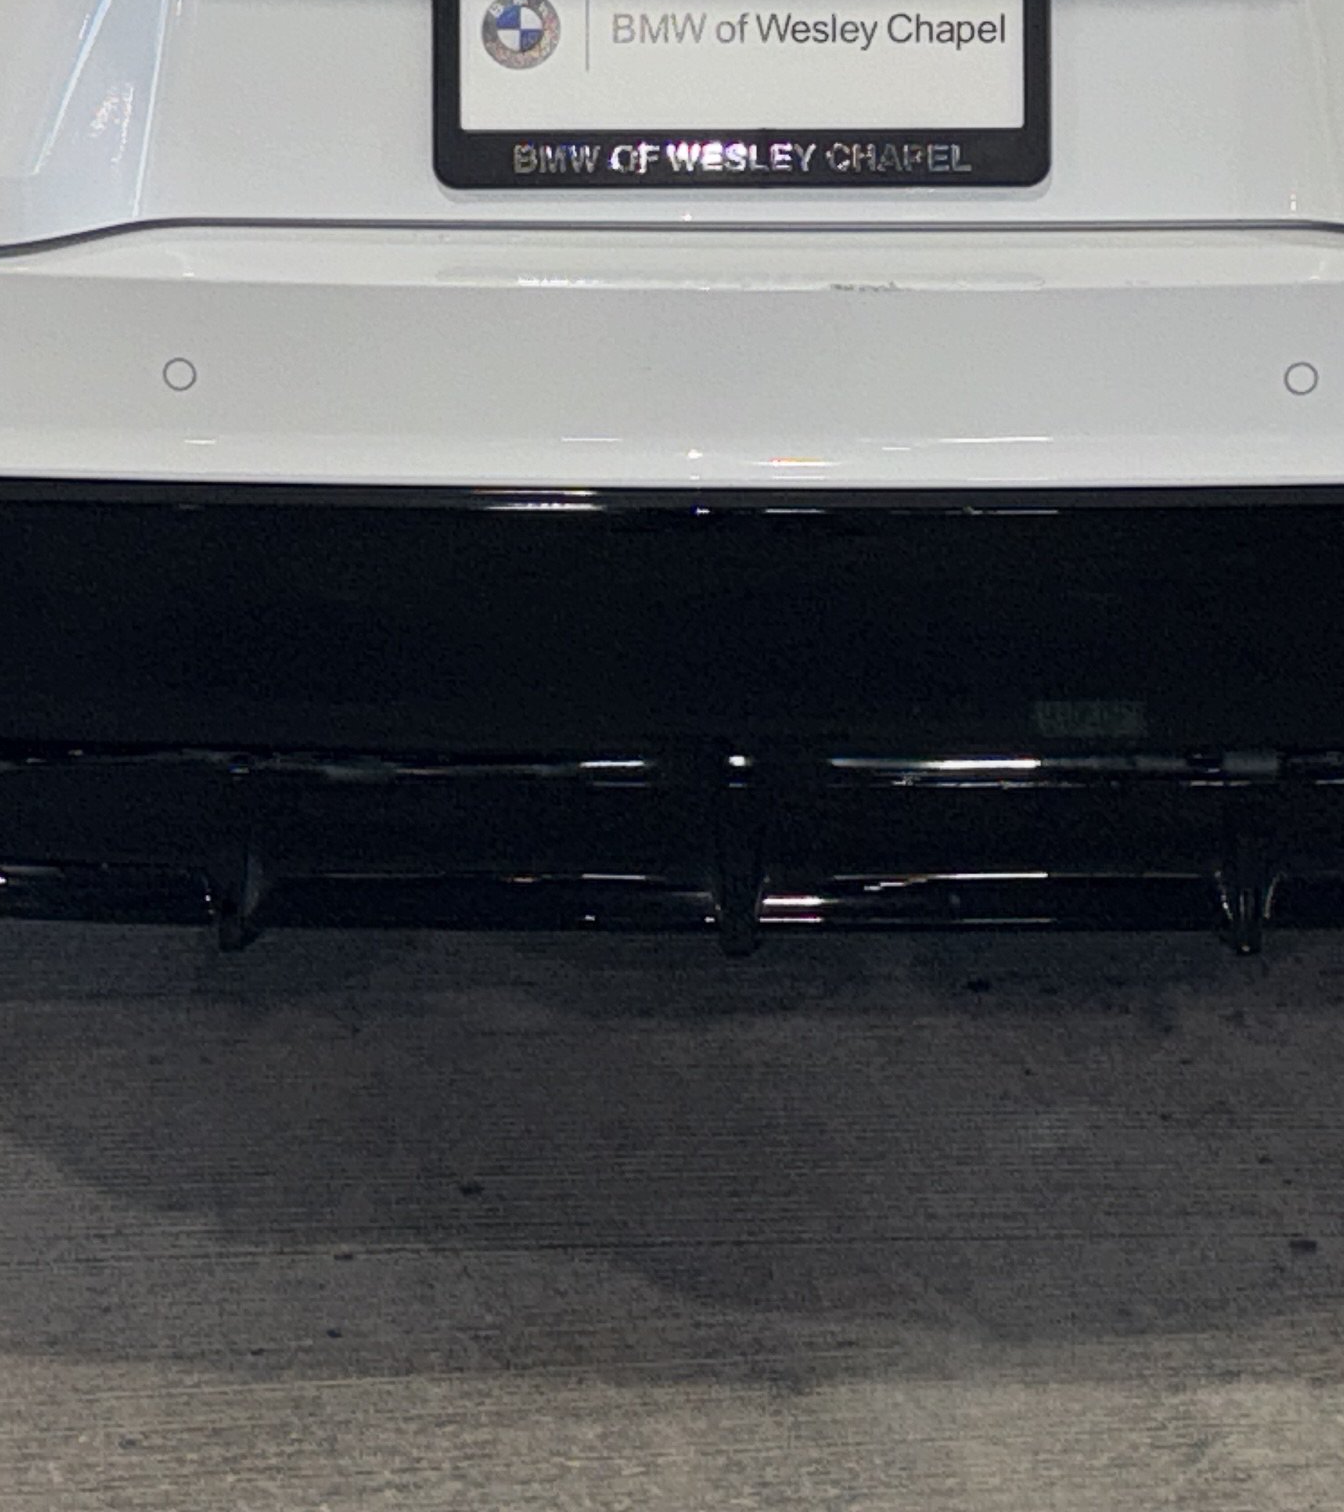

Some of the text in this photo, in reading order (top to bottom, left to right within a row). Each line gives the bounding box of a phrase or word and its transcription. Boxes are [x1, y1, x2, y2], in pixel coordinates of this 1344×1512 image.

[612, 13, 1006, 51] BMW of Wesley Chapel
[513, 141, 972, 174] BMW OF WESLEY CHAPEL
